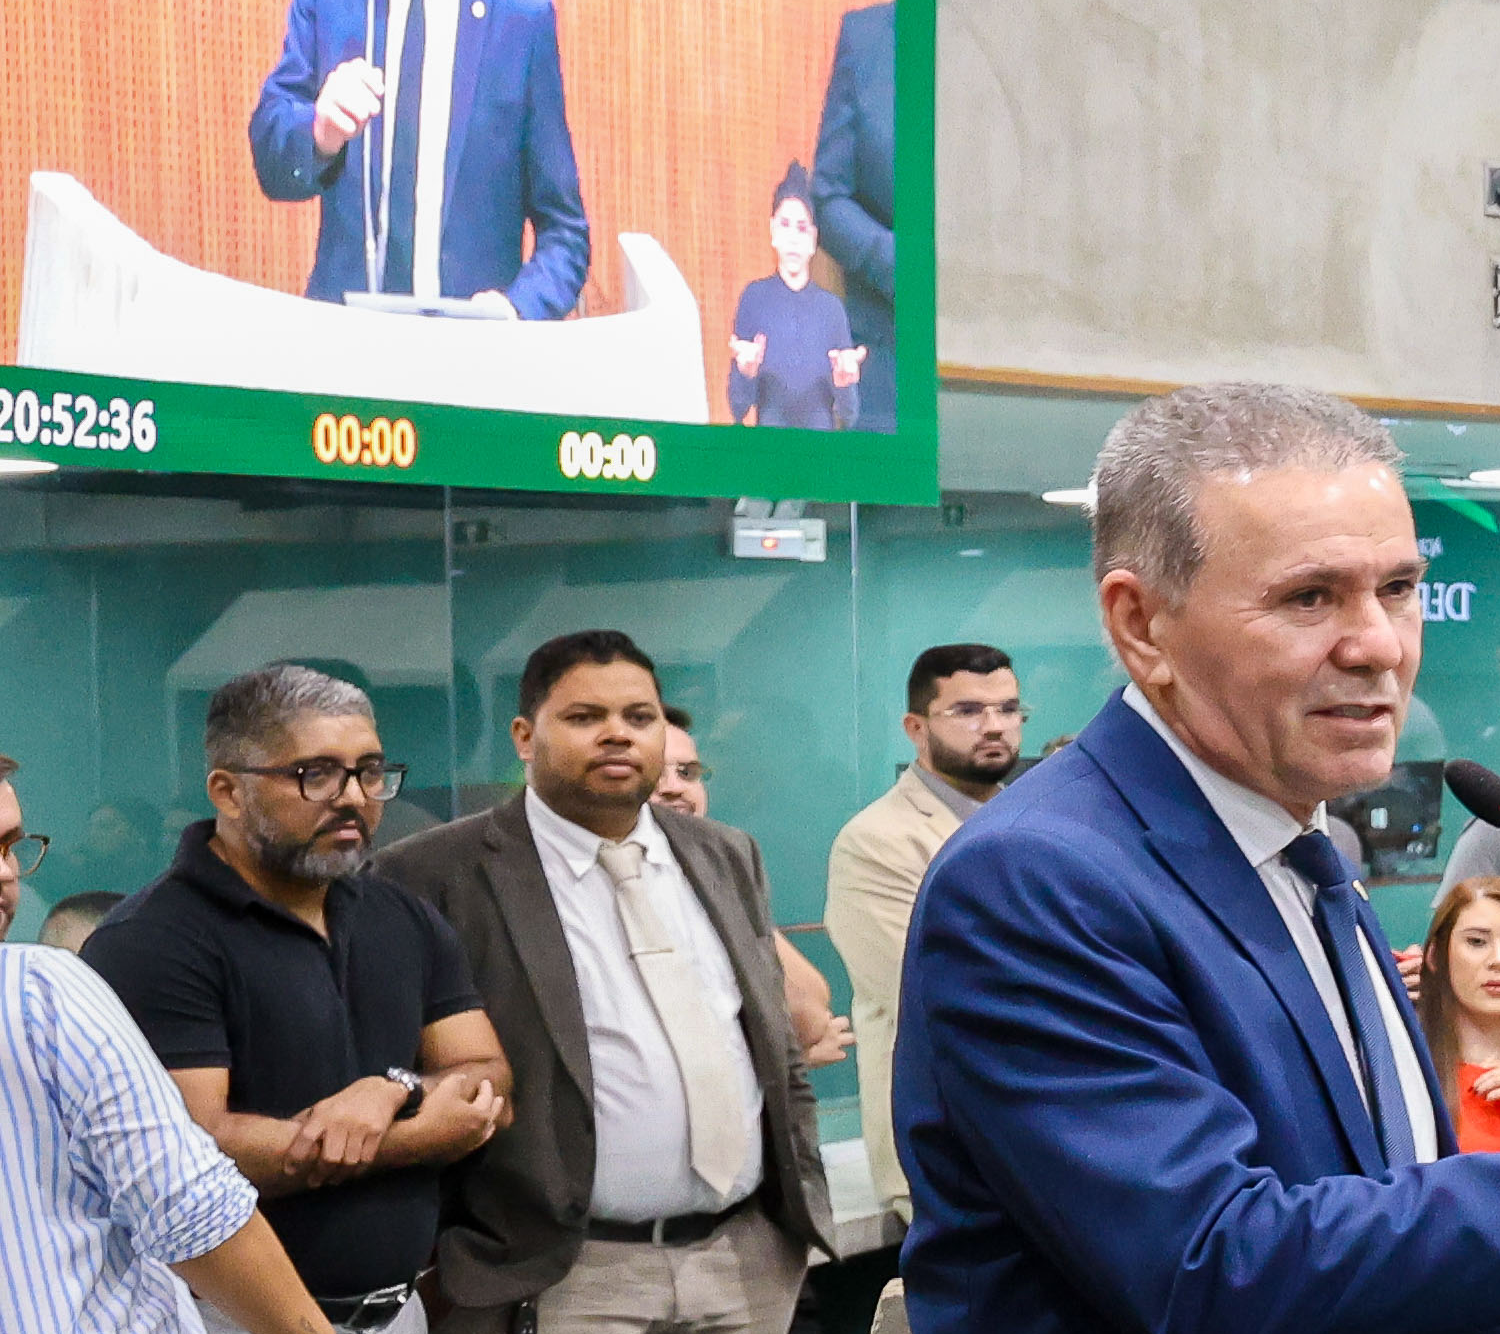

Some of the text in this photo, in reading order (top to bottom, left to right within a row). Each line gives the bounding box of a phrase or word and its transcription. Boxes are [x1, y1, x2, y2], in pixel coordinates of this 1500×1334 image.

[0, 388, 158, 454] 20:52:36
[312, 411, 418, 469] 00:00
[558, 430, 656, 482] 00:00
